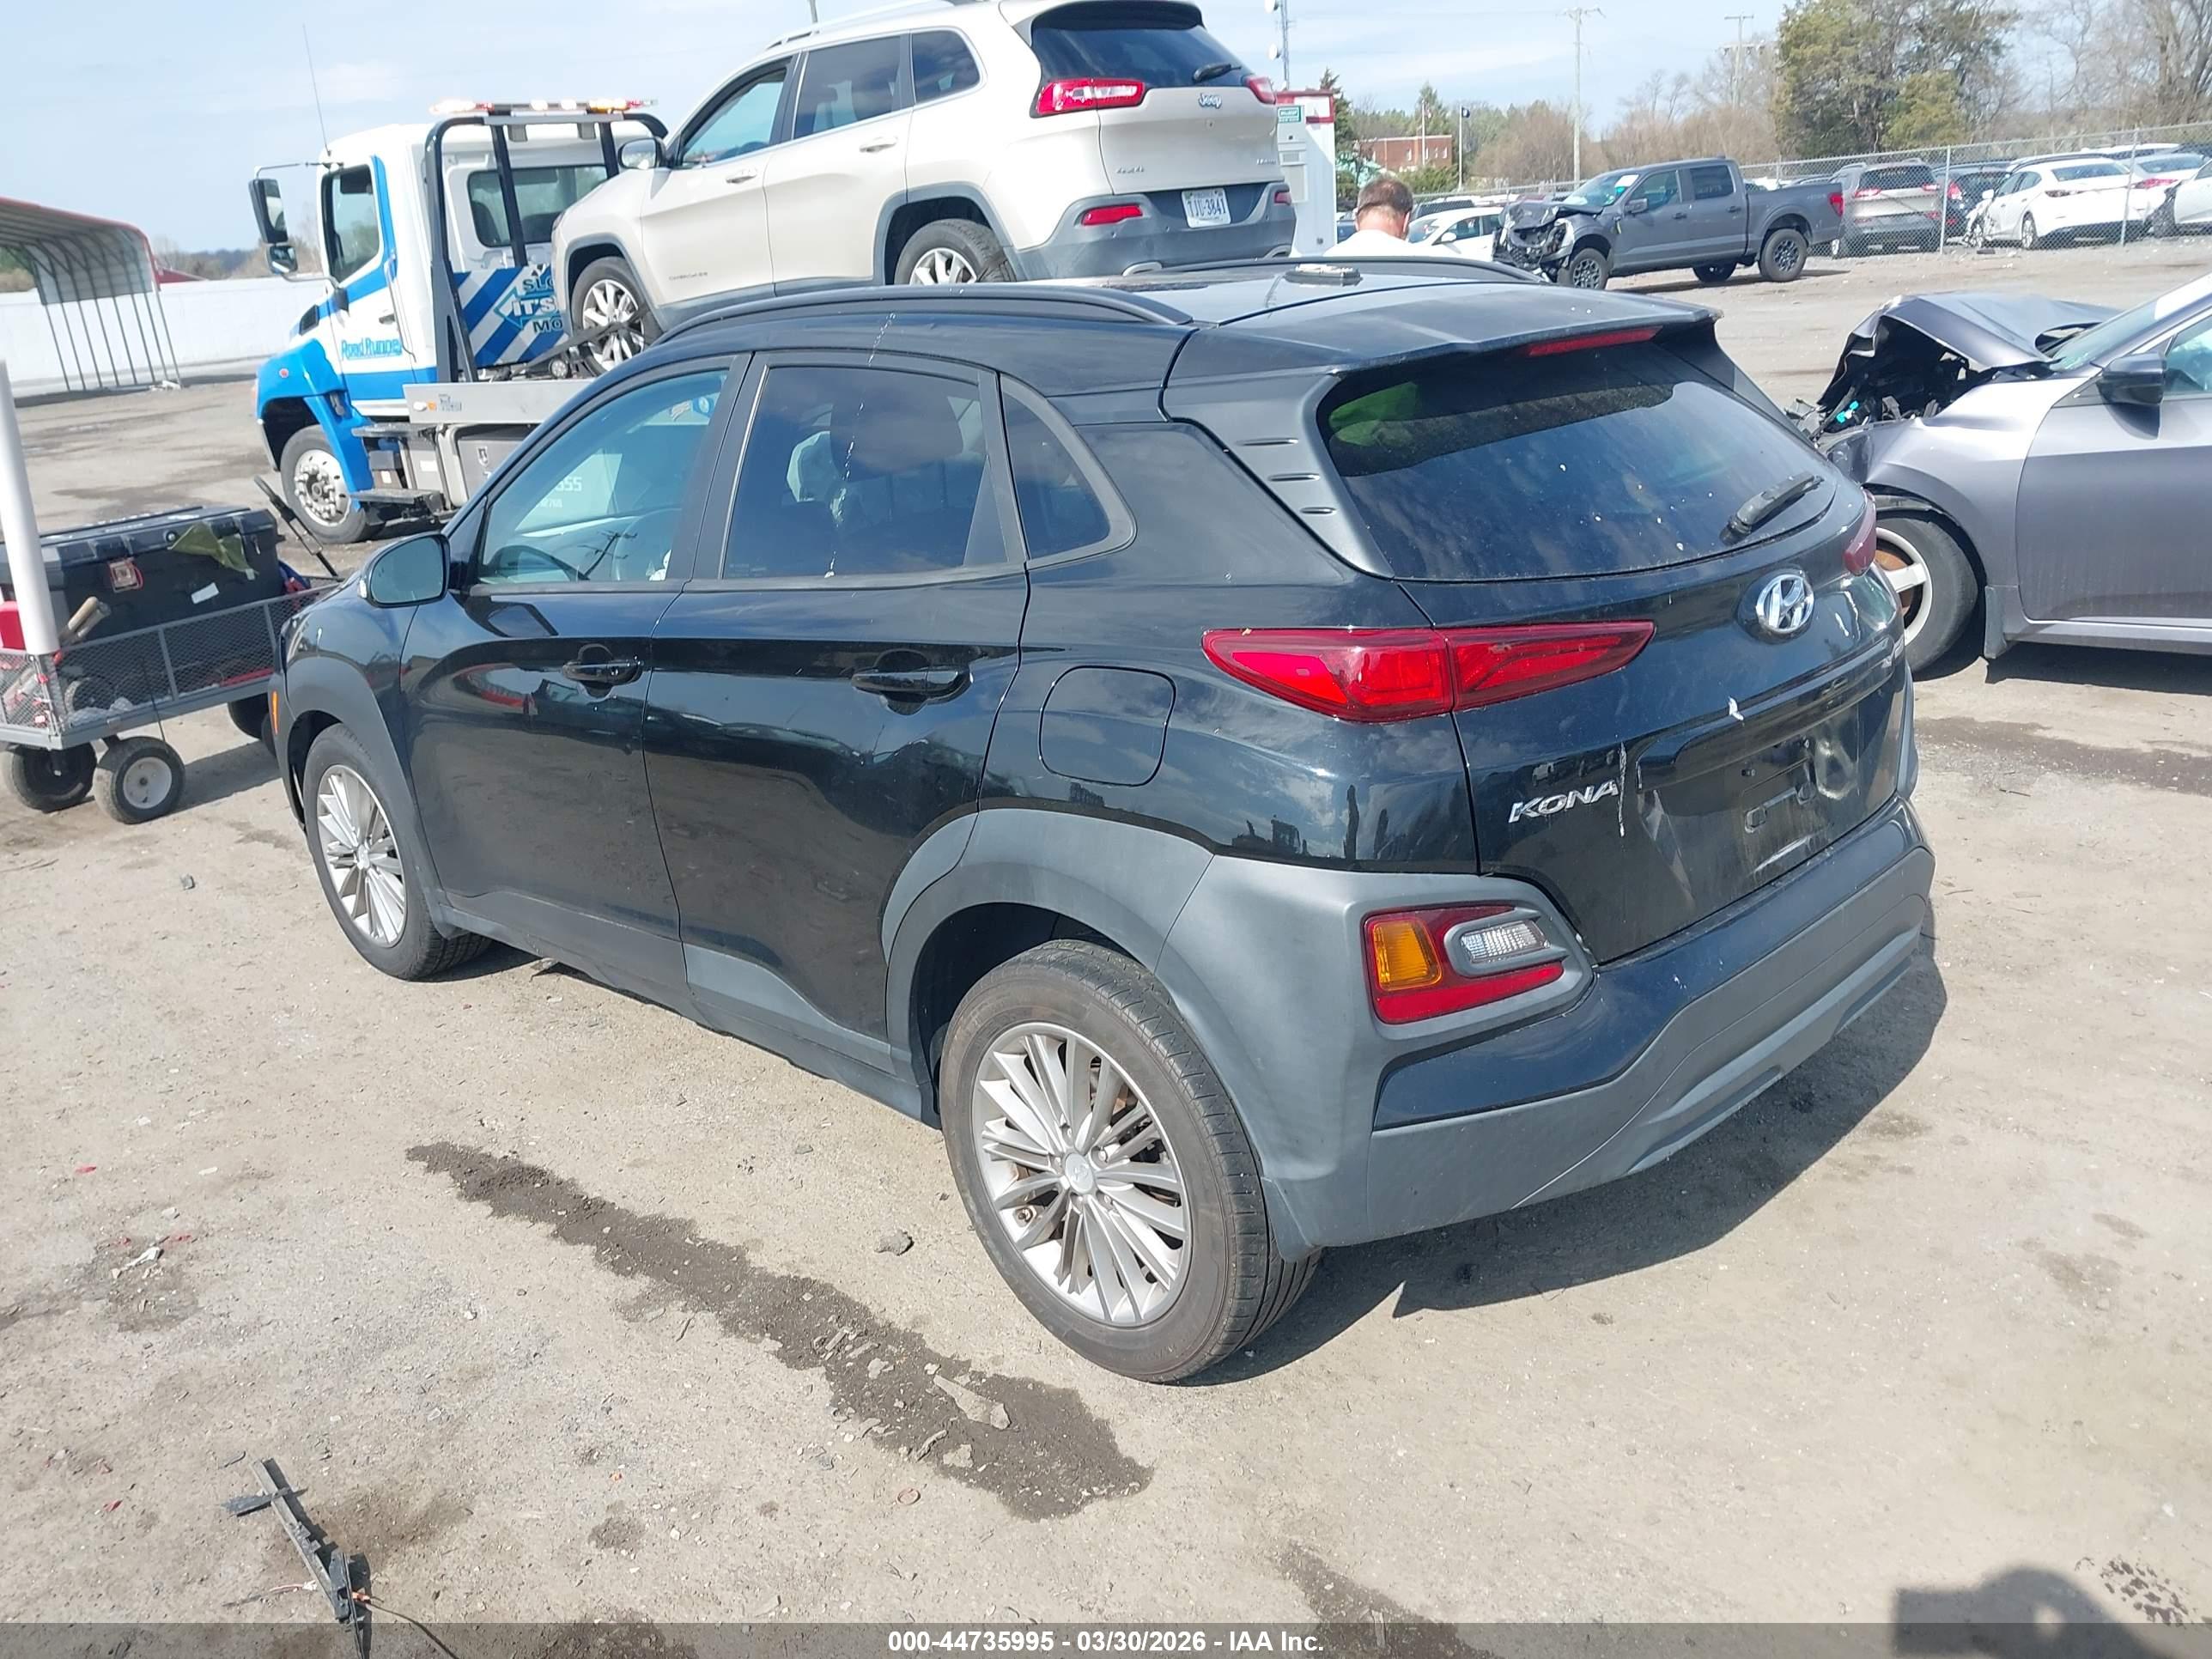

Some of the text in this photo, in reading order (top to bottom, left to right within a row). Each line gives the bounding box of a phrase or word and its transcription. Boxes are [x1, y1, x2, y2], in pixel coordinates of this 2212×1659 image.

[1198, 93, 1222, 109] Jeep
[513, 297, 557, 317] IT'S
[1508, 780, 1619, 823] KONA
